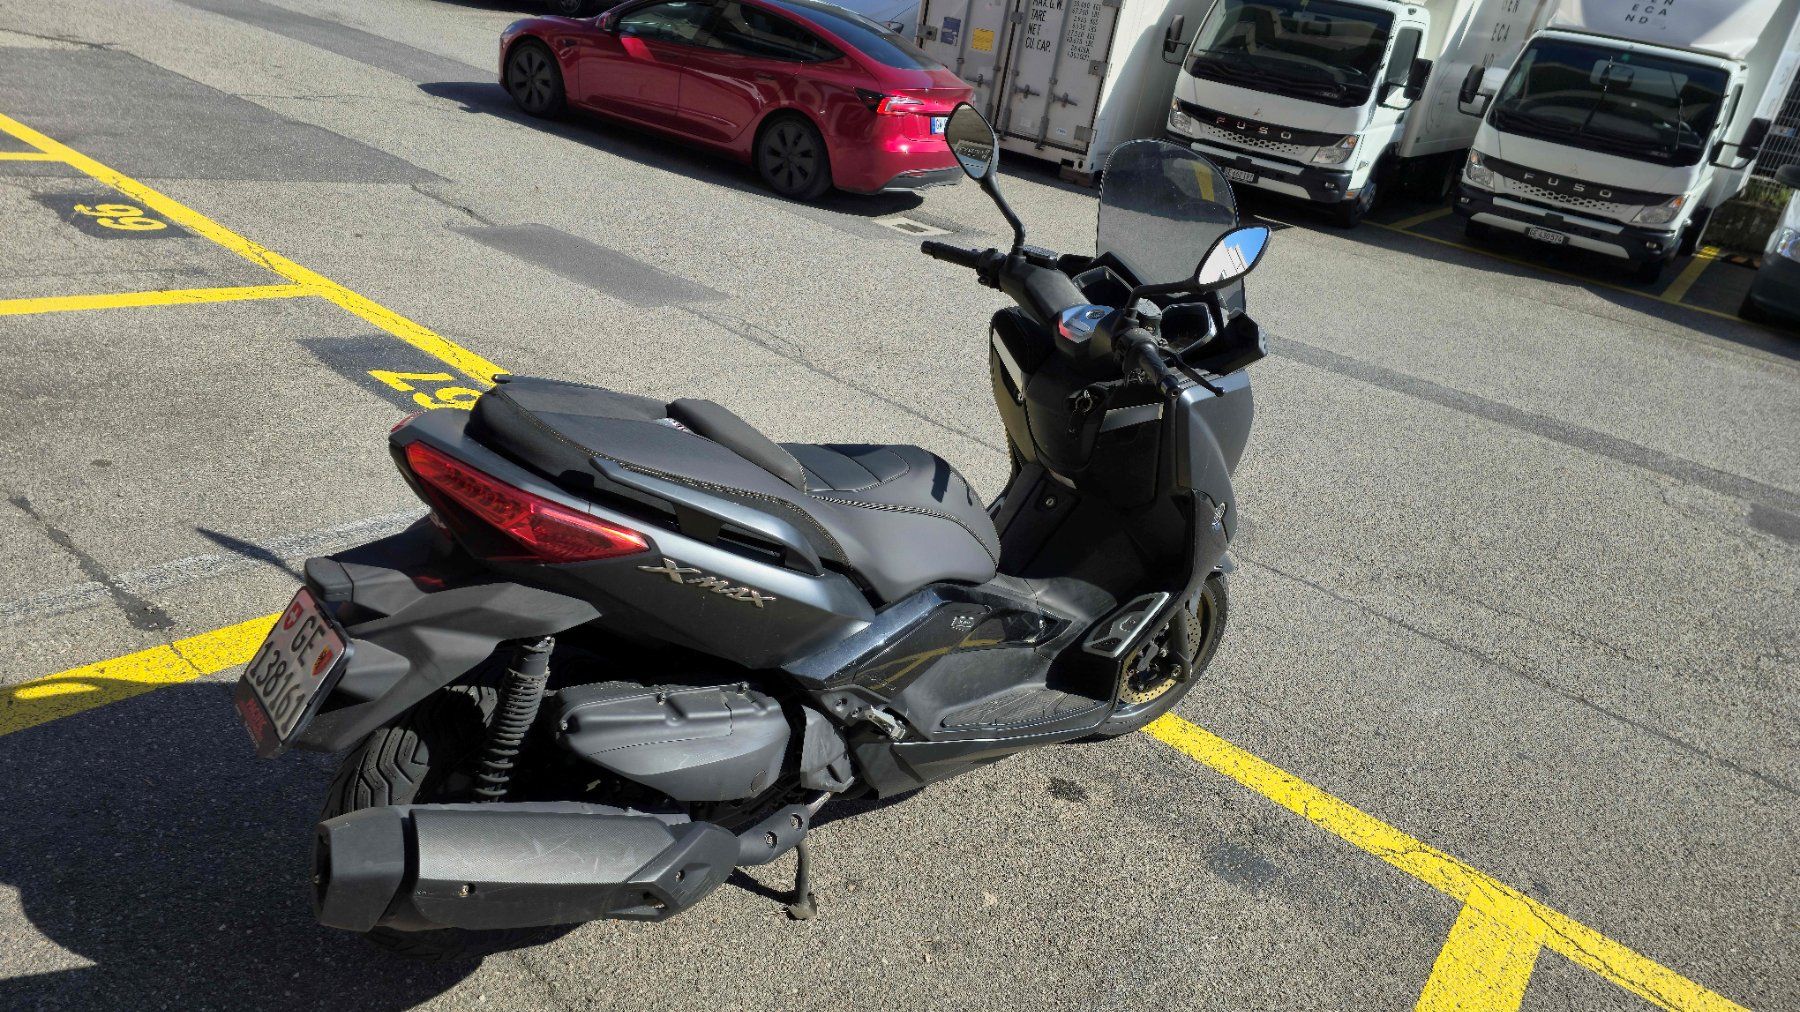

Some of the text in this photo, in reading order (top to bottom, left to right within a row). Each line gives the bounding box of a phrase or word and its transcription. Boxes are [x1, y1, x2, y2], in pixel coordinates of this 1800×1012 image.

[1031, 9, 1047, 21] TARE
[1625, 14, 1648, 24] ND
[1632, 3, 1667, 16] ECA
[1027, 22, 1042, 35] NET
[1216, 117, 1292, 139] FUSO
[1524, 172, 1612, 198] FUSO
[73, 203, 167, 231] 66
[291, 615, 326, 667] GE
[249, 640, 307, 735] 138161
